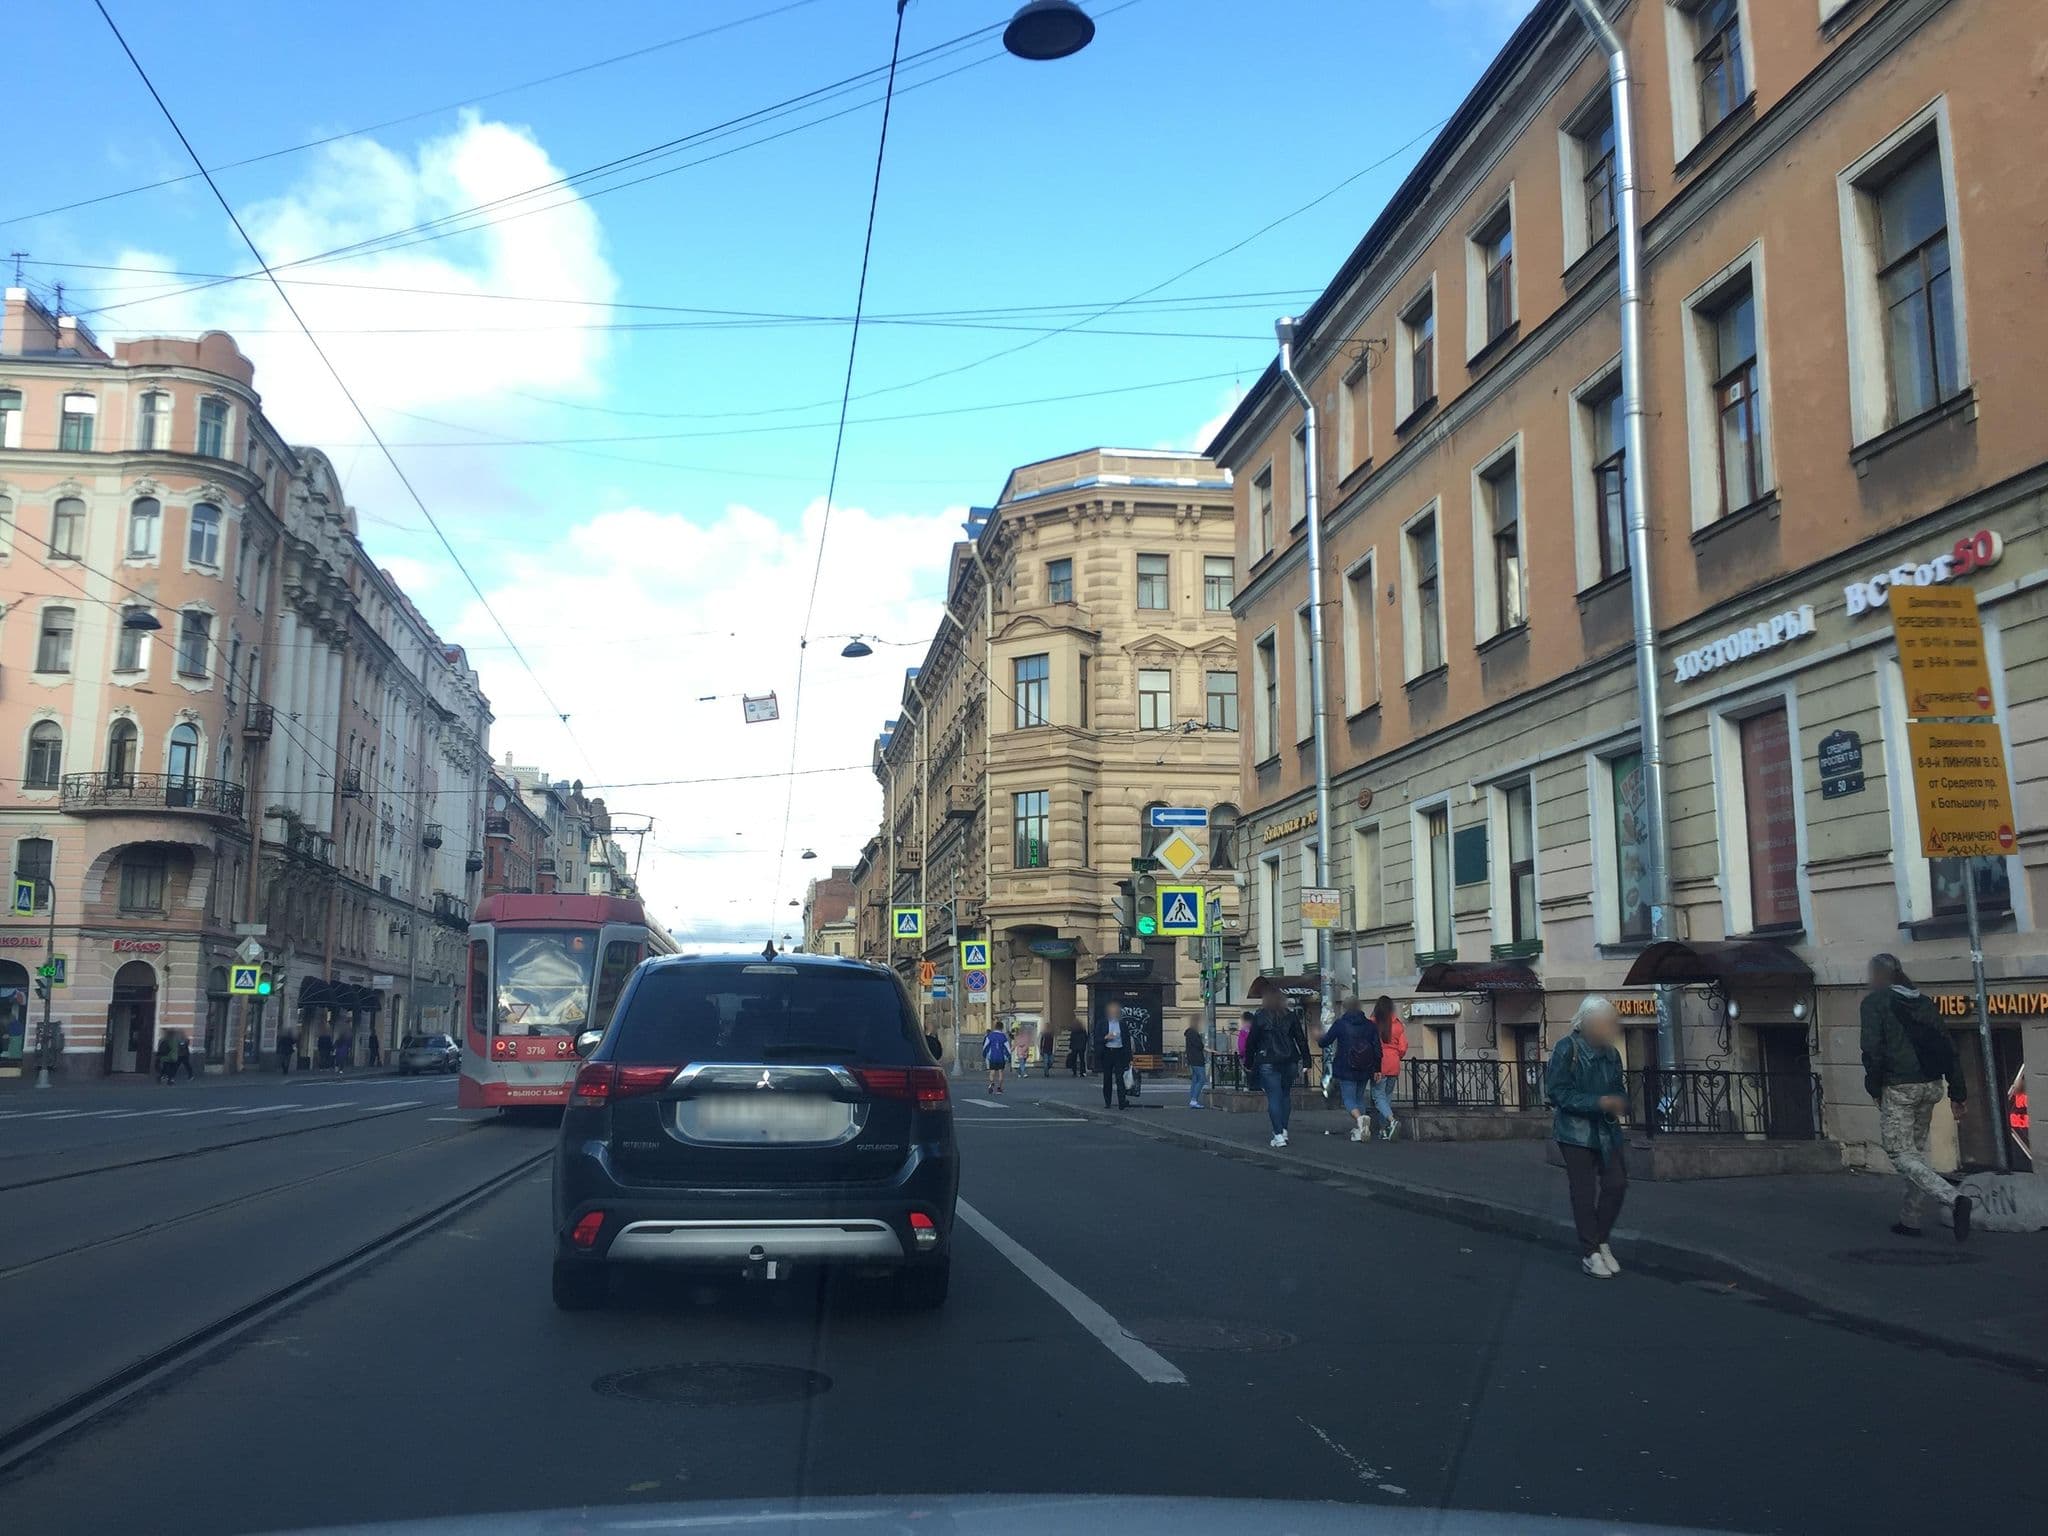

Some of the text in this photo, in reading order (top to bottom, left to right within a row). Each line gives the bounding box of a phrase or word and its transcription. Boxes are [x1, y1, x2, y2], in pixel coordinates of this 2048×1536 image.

[1674, 604, 1816, 683] ХОЗТОВАРЫ
[1929, 737, 1986, 748] Движение по
[1820, 754, 1848, 768] ПРОСПЕКТ
[1942, 756, 1982, 768] ЛИНИЯМ
[1837, 780, 1847, 792] 50
[1929, 780, 1938, 788] от
[1941, 777, 1983, 790] Среднего
[1937, 797, 1986, 810] Большому
[1940, 831, 1997, 842] ОГРАНИЧЕНО
[0, 937, 42, 947] КОЛЫ
[1633, 1000, 1657, 1015] ПЕКА
[1933, 993, 2048, 1015] ЛЕБ АЧАПУР
[526, 1046, 546, 1055] 3716
